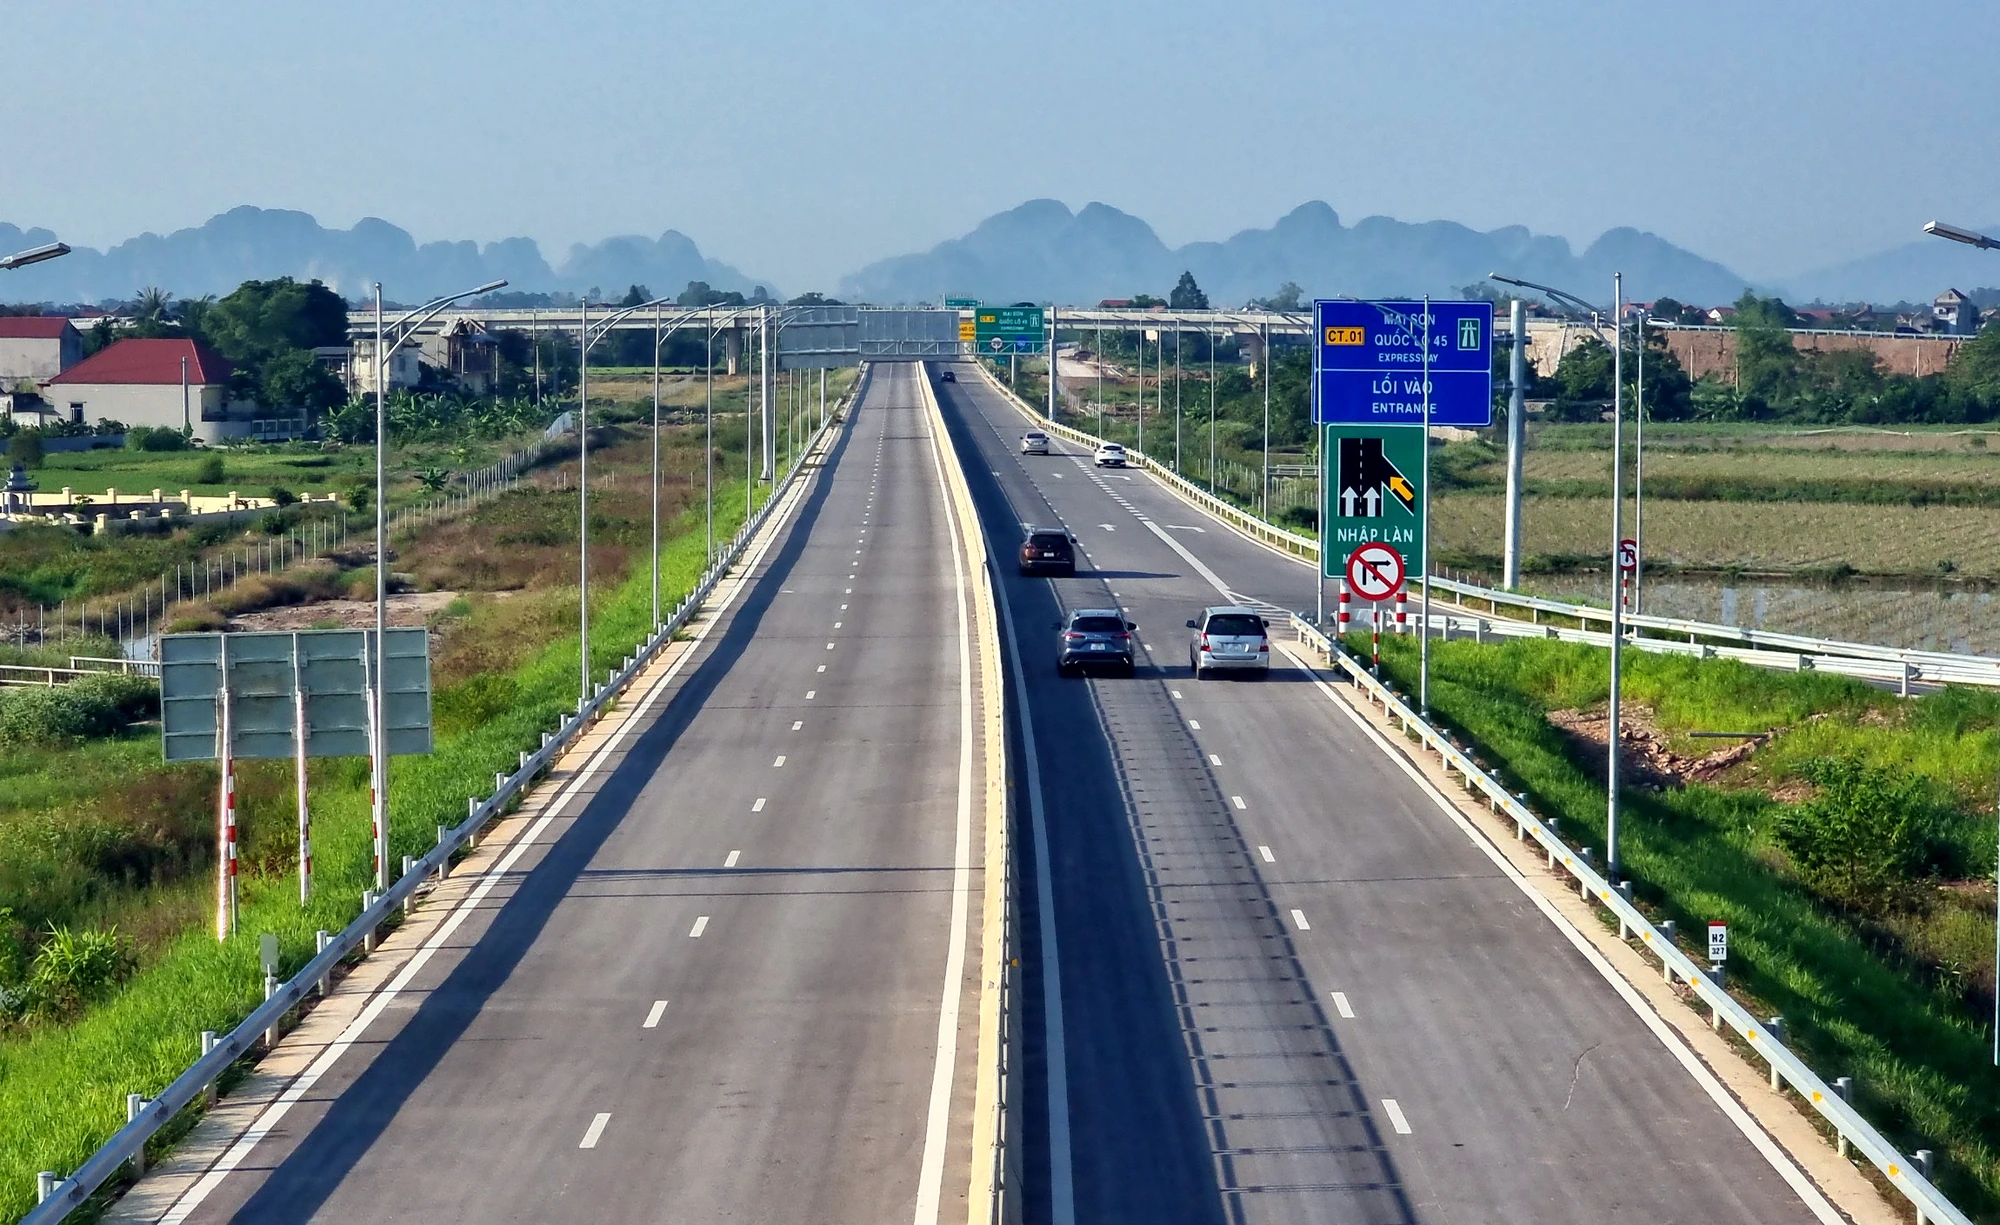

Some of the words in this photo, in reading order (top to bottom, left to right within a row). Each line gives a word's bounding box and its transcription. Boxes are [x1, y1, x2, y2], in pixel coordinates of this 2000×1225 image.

[1384, 313, 1406, 325] MAI
[1328, 330, 1362, 342] CT.01
[1374, 328, 1410, 346] QUỐC
[1433, 335, 1448, 347] 45
[1373, 372, 1398, 394] LỐI
[1404, 376, 1433, 394] VÀO
[1337, 525, 1378, 545] NHẬP
[1383, 525, 1413, 543] LÀN
[1712, 933, 1725, 943] H2
